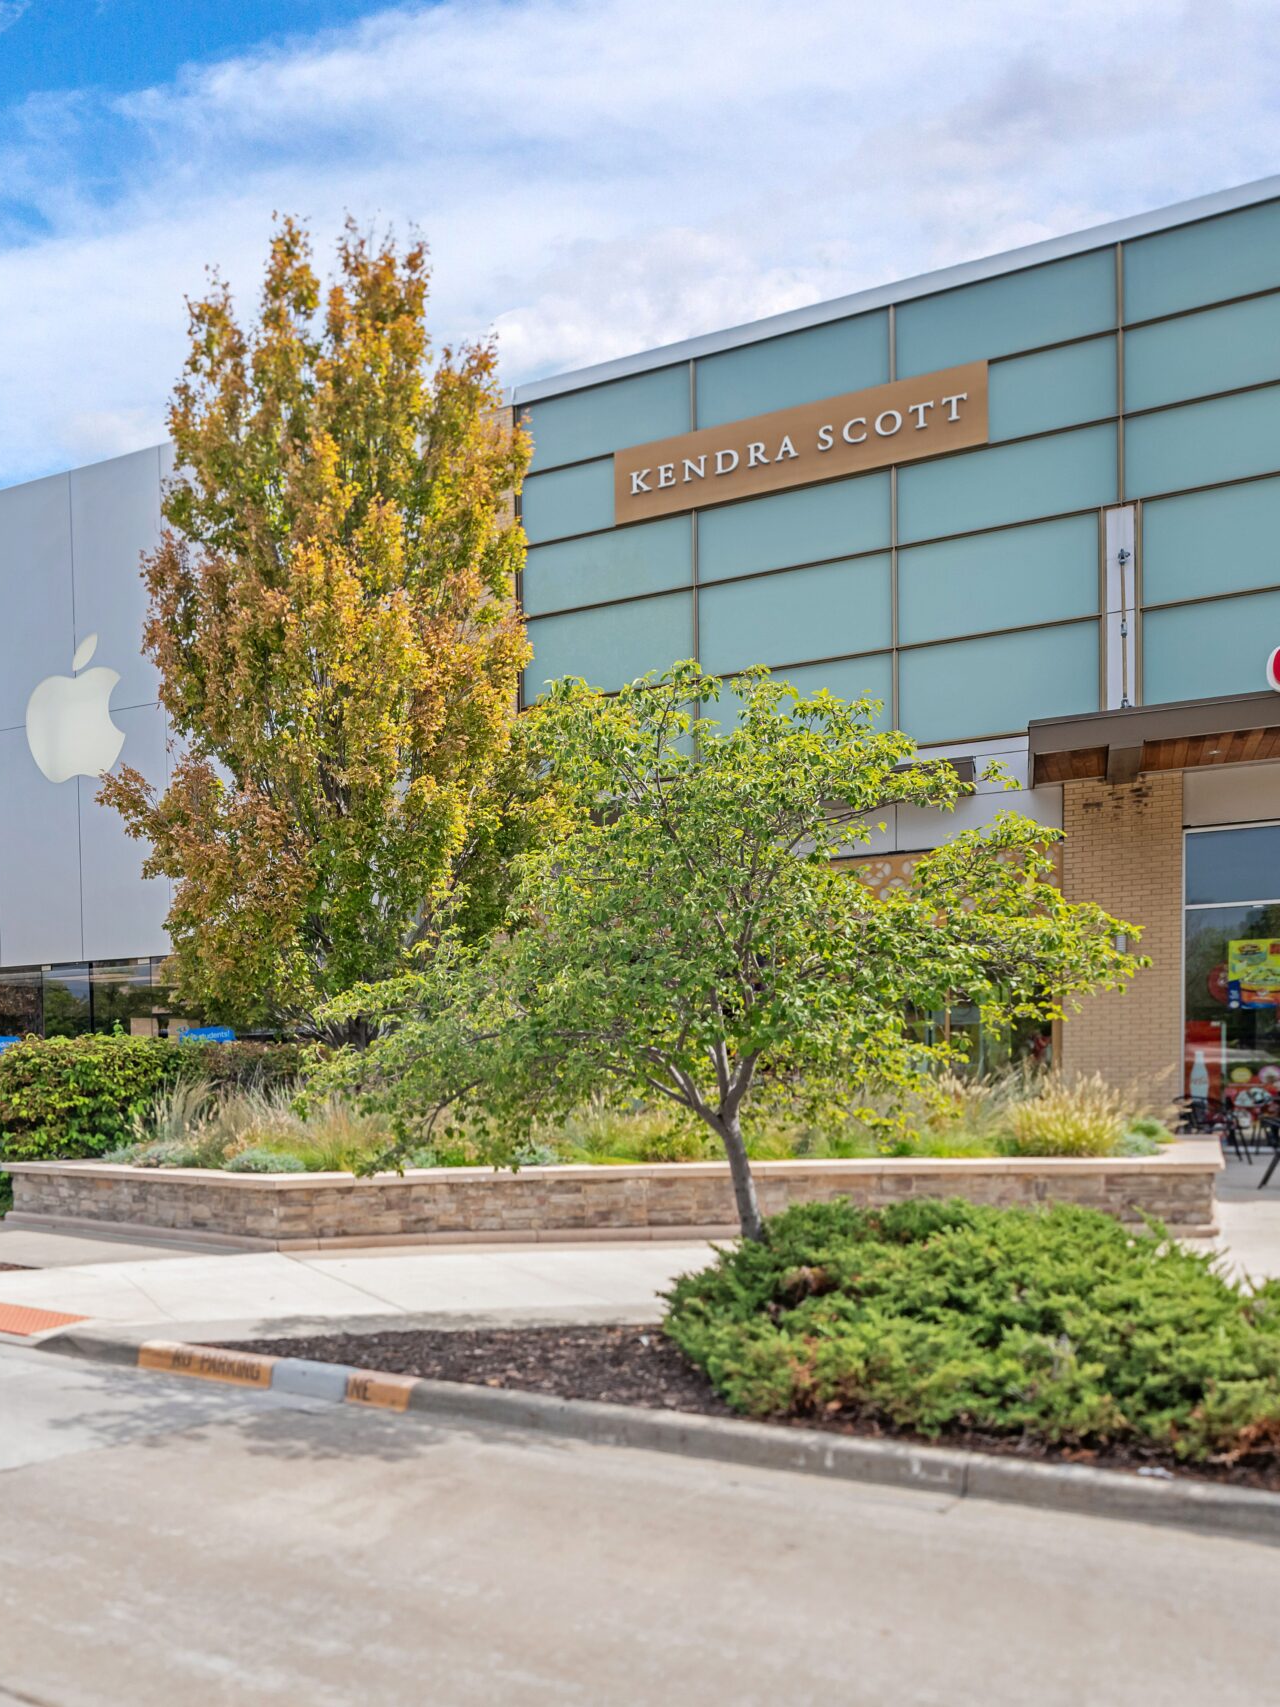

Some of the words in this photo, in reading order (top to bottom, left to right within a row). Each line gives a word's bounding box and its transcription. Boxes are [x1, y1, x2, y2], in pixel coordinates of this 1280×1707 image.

[630, 435, 799, 495] KENDRA
[817, 393, 968, 452] SCOTT
[199, 1352, 261, 1381] PARKING
